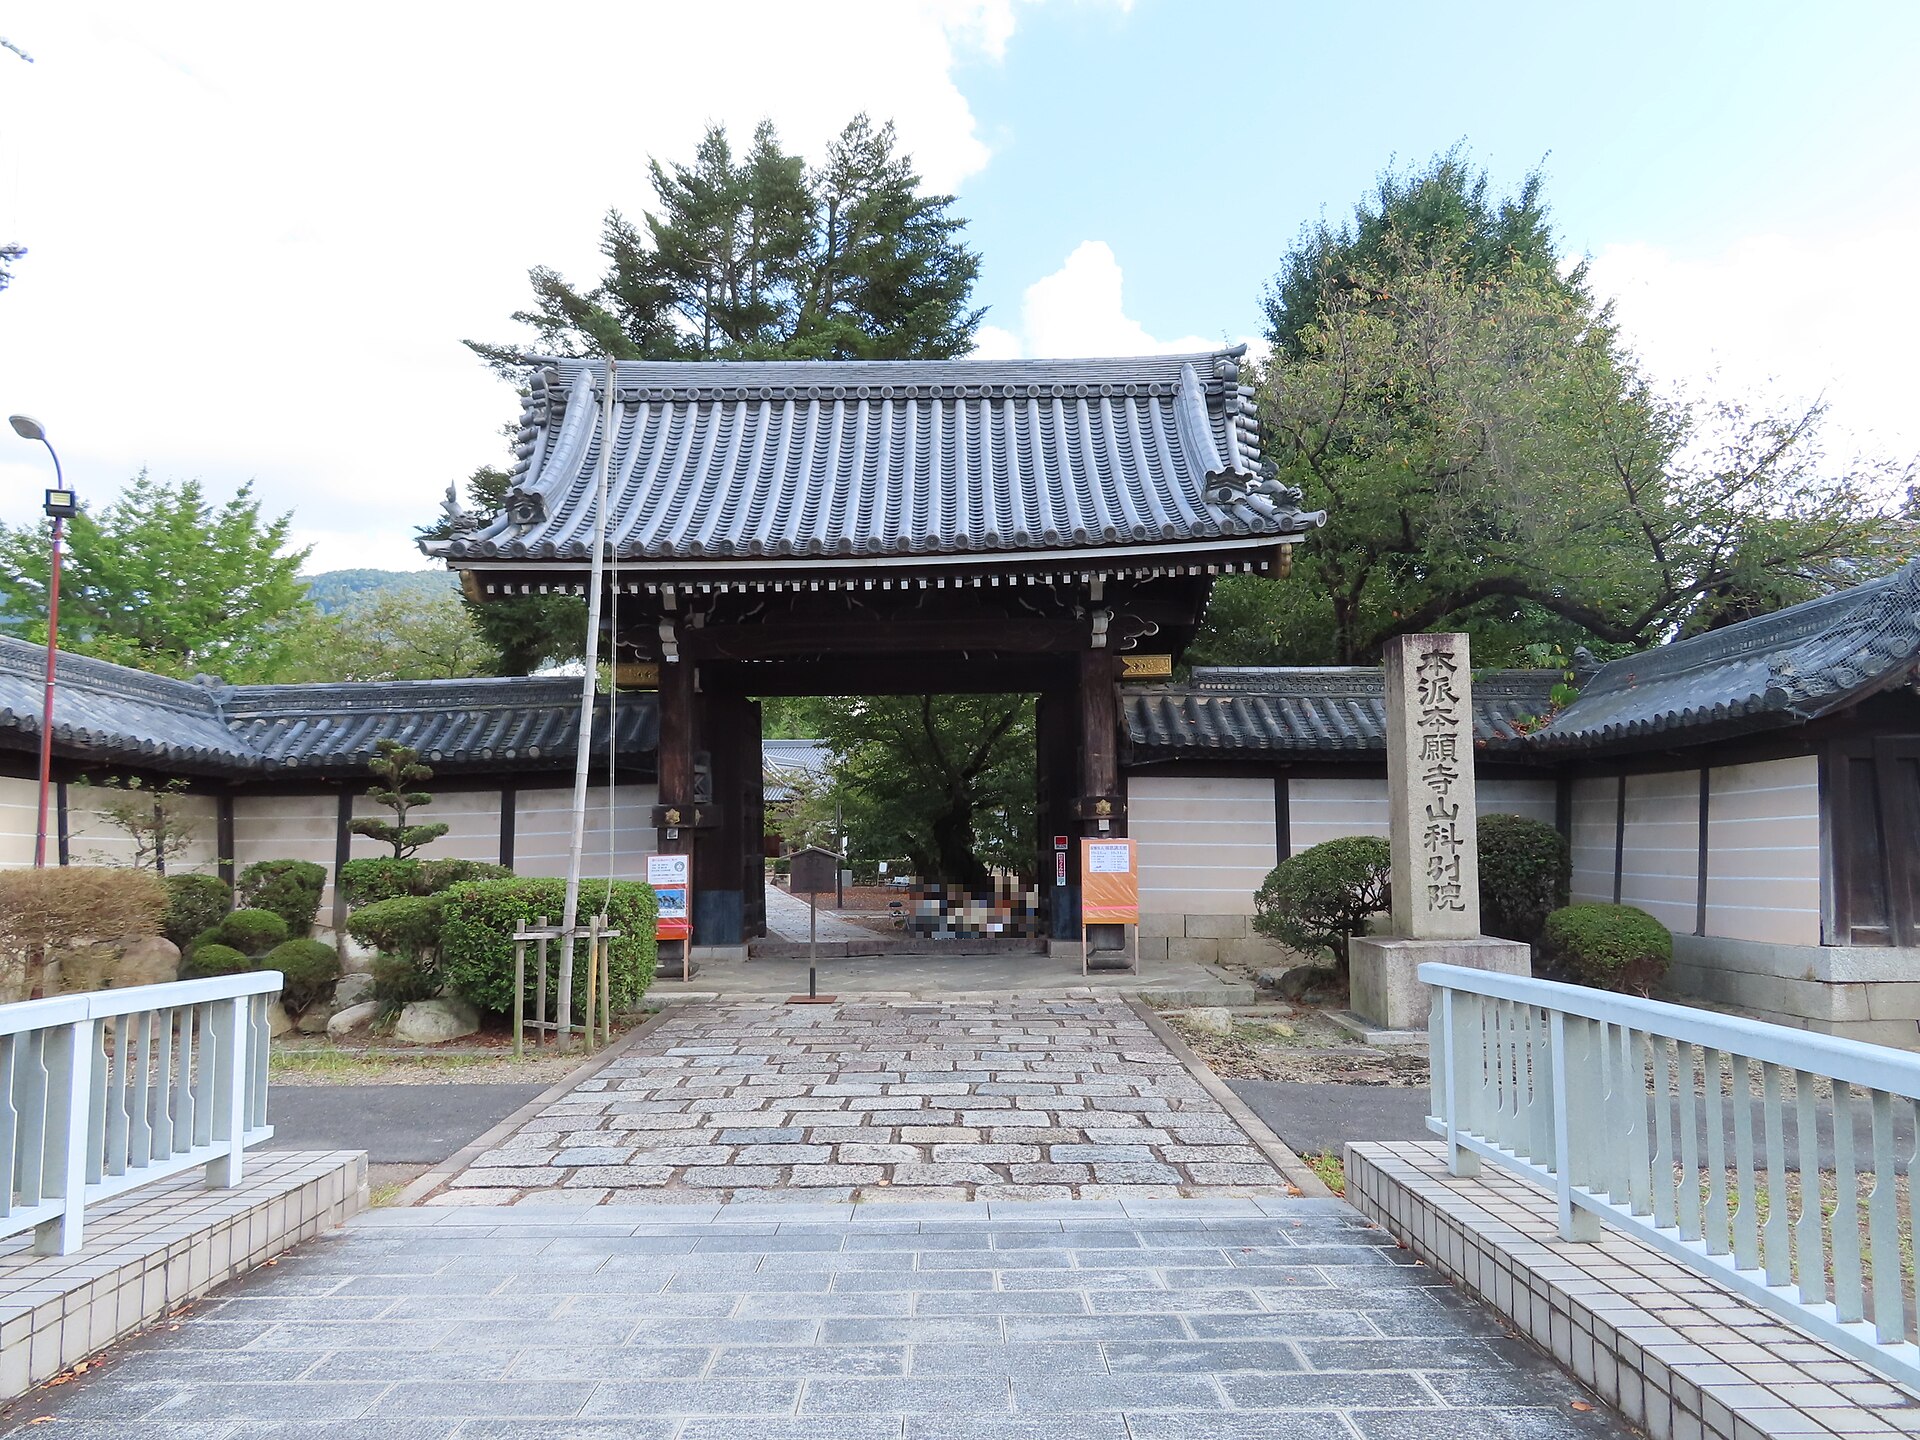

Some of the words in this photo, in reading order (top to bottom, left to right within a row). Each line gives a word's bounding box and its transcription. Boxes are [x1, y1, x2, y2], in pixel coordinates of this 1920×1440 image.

[1416, 648, 1466, 912] 本派本願寺山科別院
